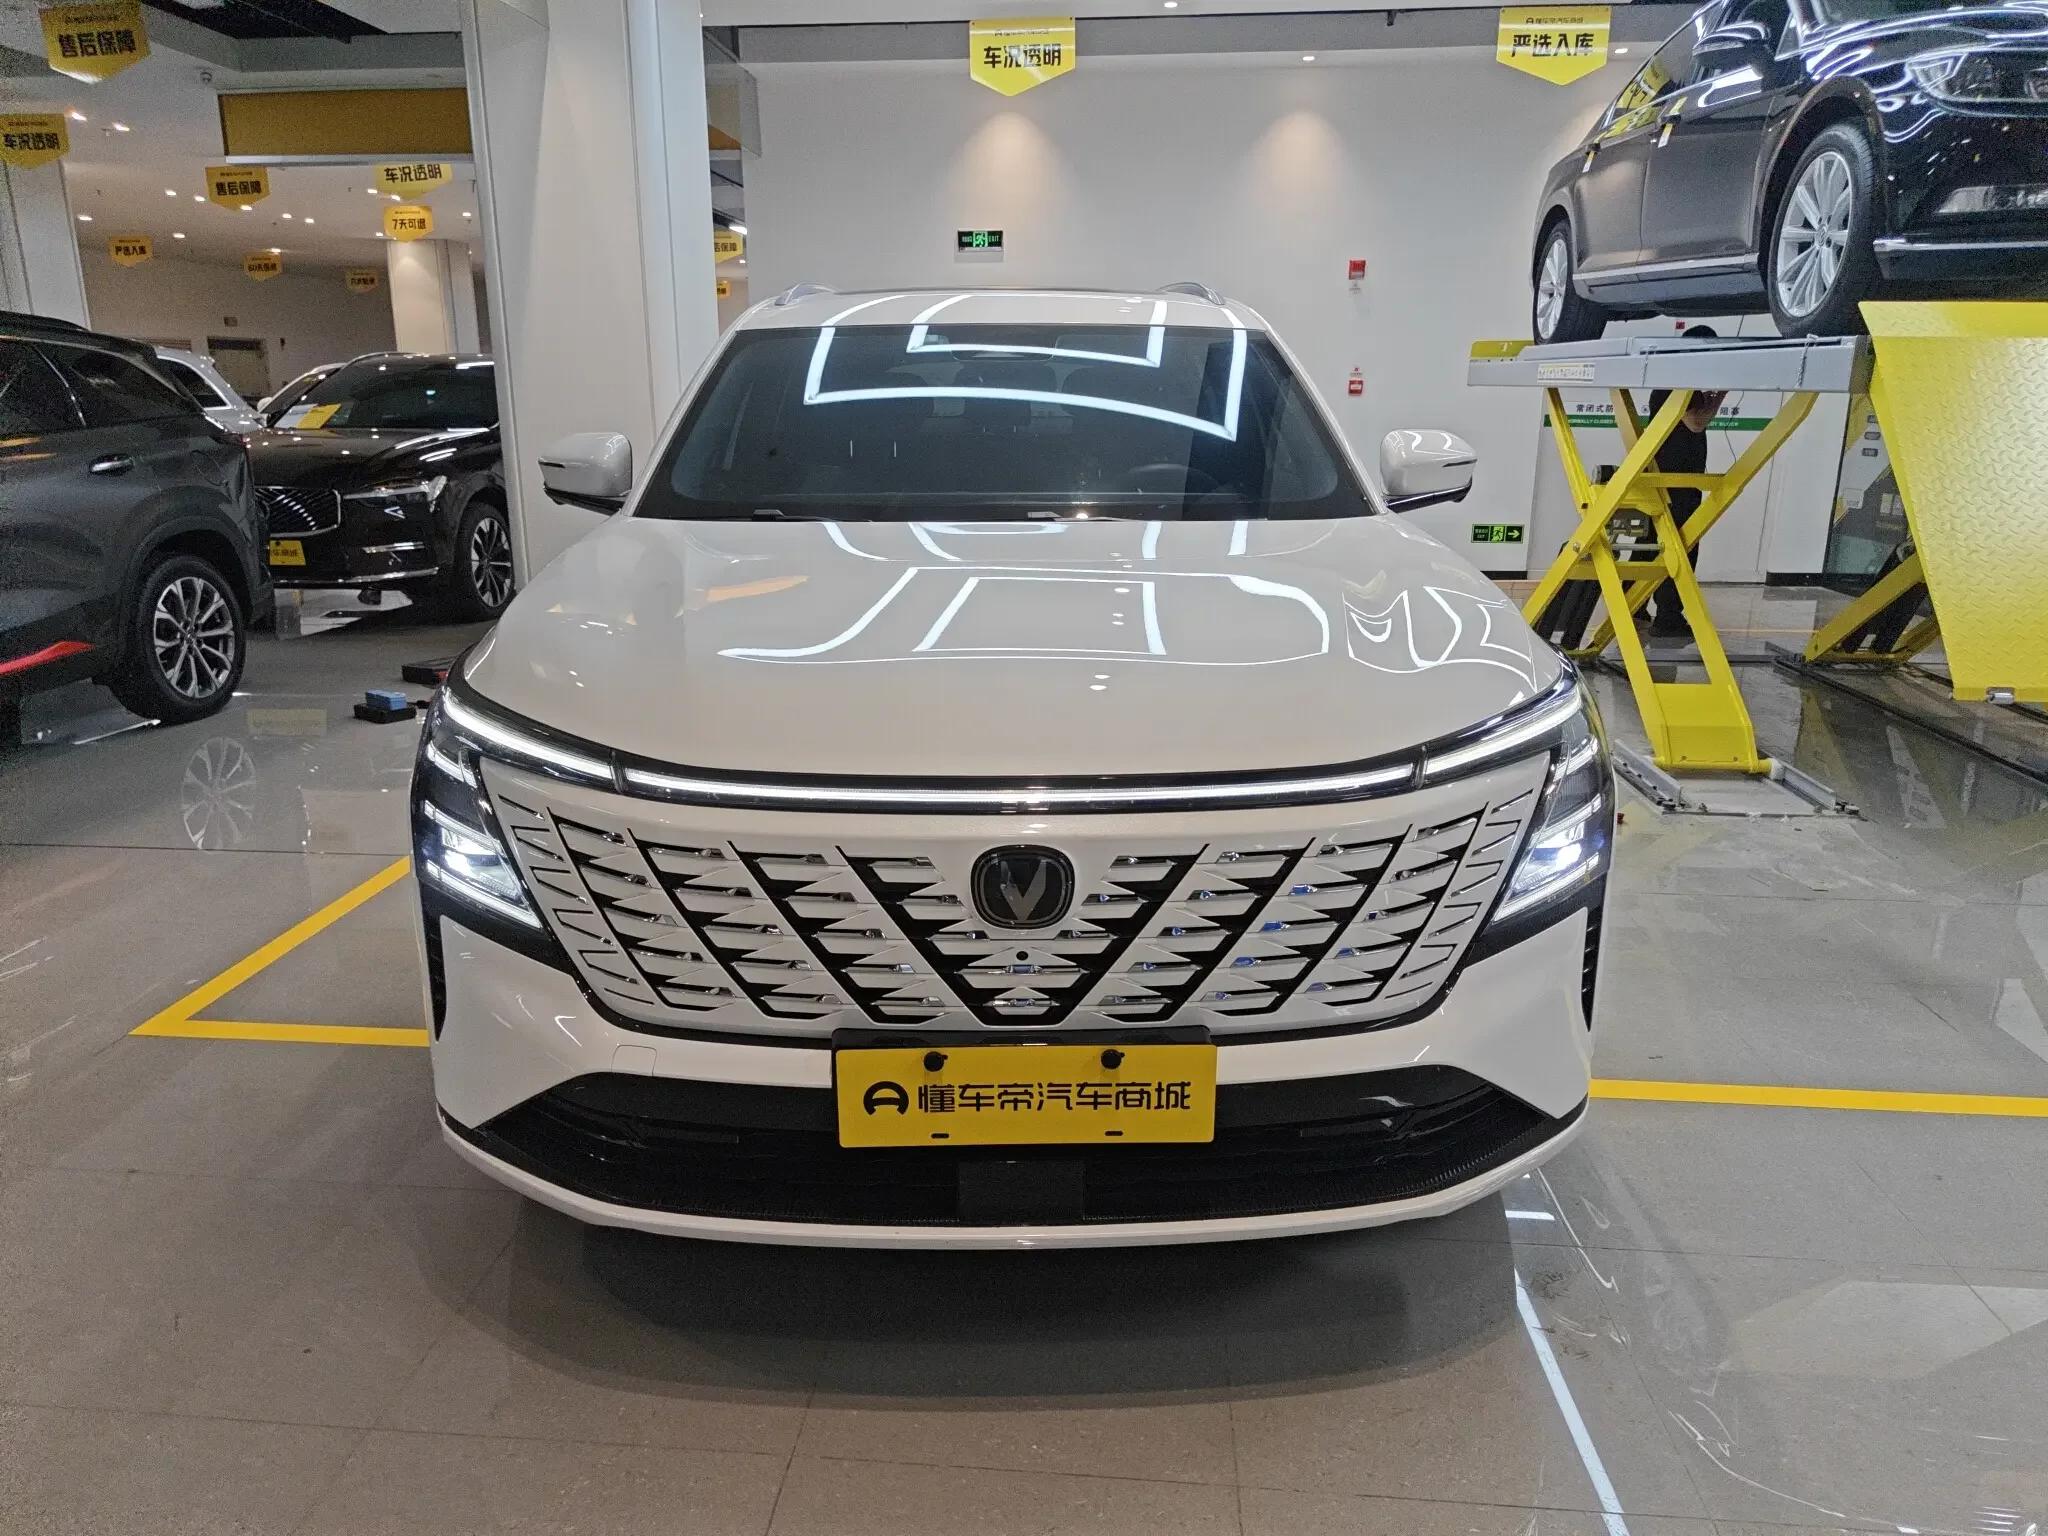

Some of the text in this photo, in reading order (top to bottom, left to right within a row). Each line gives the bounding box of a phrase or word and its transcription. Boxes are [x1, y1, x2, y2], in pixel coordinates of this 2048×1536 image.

[58, 29, 137, 58] 售后保障
[1511, 32, 1595, 57] 严选入库
[983, 43, 1062, 69] 车况透明
[4, 132, 60, 150] 车况透明
[384, 164, 443, 184] 车况透明
[216, 180, 262, 196] 售后保障
[392, 218, 427, 230] 7天可退
[917, 1080, 1192, 1113] 懂车帝汽车商城
